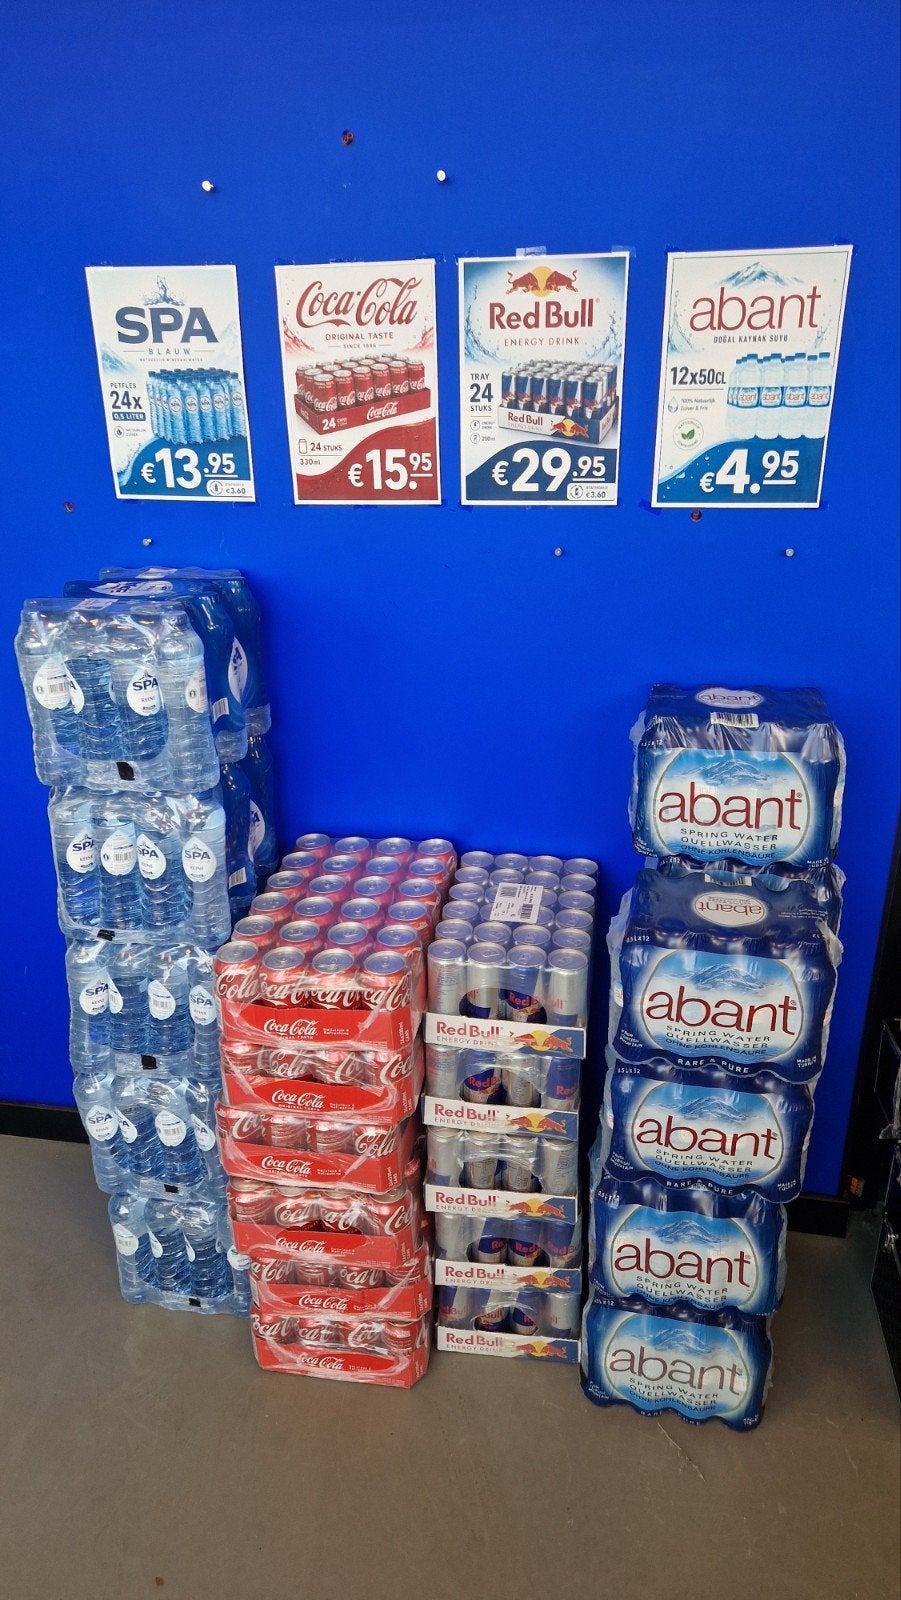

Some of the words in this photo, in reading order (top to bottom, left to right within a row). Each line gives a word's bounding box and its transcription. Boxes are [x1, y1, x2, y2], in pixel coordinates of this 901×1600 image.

[489, 300, 540, 330] Red
[545, 298, 594, 328] Bull
[689, 285, 821, 332] abant
[115, 306, 218, 344] SPA
[504, 337, 544, 347] ENERGY
[548, 337, 579, 346] DRINK
[738, 334, 767, 343] KAYNAK
[769, 334, 788, 342] SUYU
[110, 391, 143, 409] 24x
[470, 383, 493, 402] 24
[322, 417, 336, 430] 24
[508, 412, 524, 422] Red
[526, 415, 543, 425] Bull
[310, 442, 321, 451] 24
[299, 458, 321, 466] 330ml
[132, 677, 159, 691] SPA
[658, 781, 802, 830] abant
[681, 828, 728, 838] SPRING
[734, 832, 778, 842] WATER
[681, 837, 776, 851] QUELLWASSER
[681, 845, 705, 855] OHNE
[185, 849, 210, 860] SPA
[698, 901, 762, 916] abant
[85, 983, 109, 996] SPA
[645, 985, 797, 1035] abant
[436, 1021, 467, 1036] Red
[470, 1025, 500, 1038] Bull
[666, 1025, 717, 1037] SPRING
[722, 1031, 770, 1042] WATER
[436, 1036, 470, 1045] ENERGY
[665, 1038, 692, 1049] OHNE
[666, 1032, 768, 1049] QUELLWASSER
[677, 1058, 705, 1066] RARE
[721, 1061, 749, 1074] PURE
[88, 1113, 112, 1125] SPA
[434, 1103, 464, 1117] Red
[466, 1108, 496, 1121] Bull
[434, 1117, 467, 1126] ENERGY
[636, 1115, 777, 1160] abant
[655, 1155, 751, 1172] QUELLWASSER
[656, 1149, 703, 1160] SPRING
[709, 1156, 753, 1166] WATER
[654, 1160, 679, 1171] OHNE
[708, 1182, 734, 1195] PURE
[435, 1191, 464, 1205] Red
[468, 1194, 496, 1207] Bull
[436, 1204, 469, 1212] ENERGY
[614, 1237, 751, 1287] abant
[445, 1266, 474, 1278] Red
[477, 1268, 504, 1279] Bull
[637, 1275, 681, 1289] SPRING
[687, 1283, 728, 1296] WATER
[637, 1283, 727, 1303] QUELLWASSER
[446, 1333, 474, 1345] Red
[609, 1345, 740, 1395] abant
[629, 1377, 673, 1391] SPRING
[678, 1387, 718, 1399] WATER
[629, 1384, 717, 1406] QUELLWASSER
